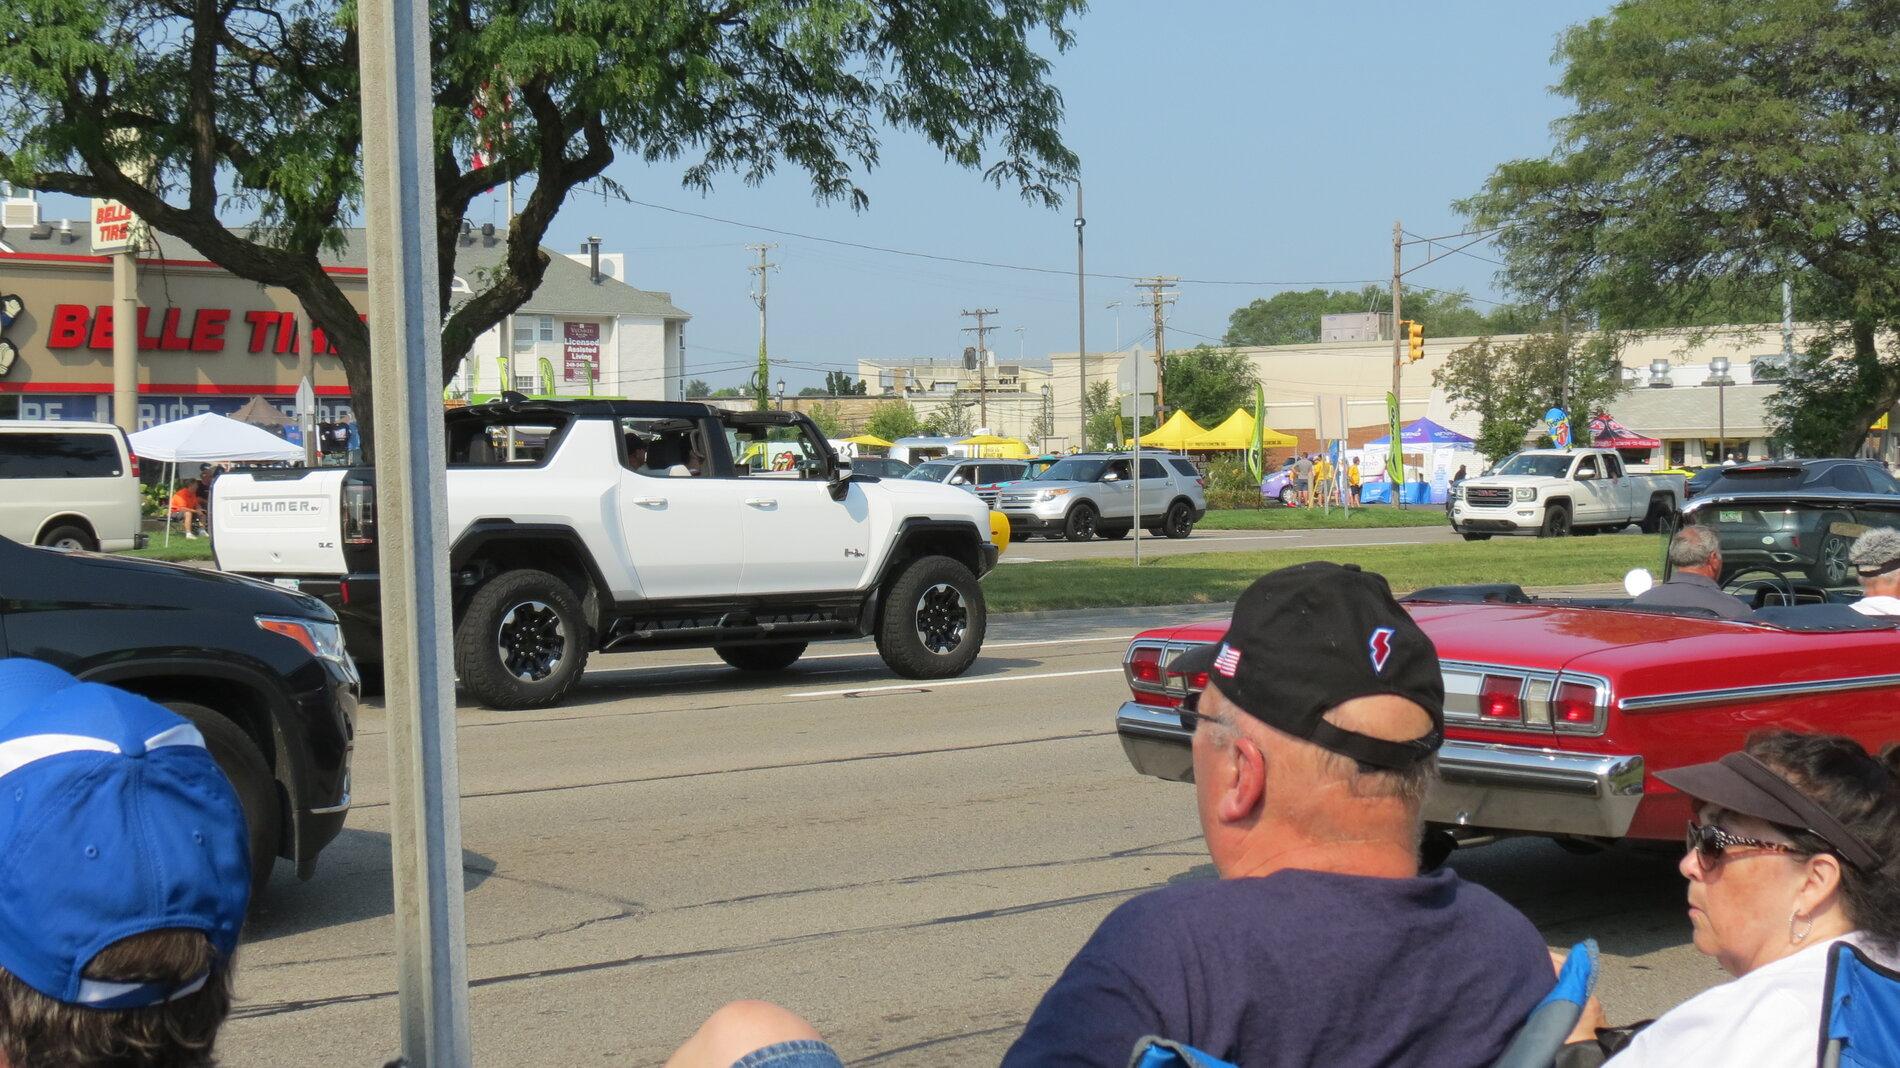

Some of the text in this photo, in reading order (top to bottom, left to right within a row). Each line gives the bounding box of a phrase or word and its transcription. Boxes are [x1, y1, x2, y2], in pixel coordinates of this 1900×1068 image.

[96, 205, 132, 224] BELLE
[100, 222, 129, 242] TIRE
[47, 303, 368, 354] BELLE TI
[564, 337, 600, 346] Licensed
[571, 353, 593, 361] Living
[240, 501, 310, 512] HUMMER
